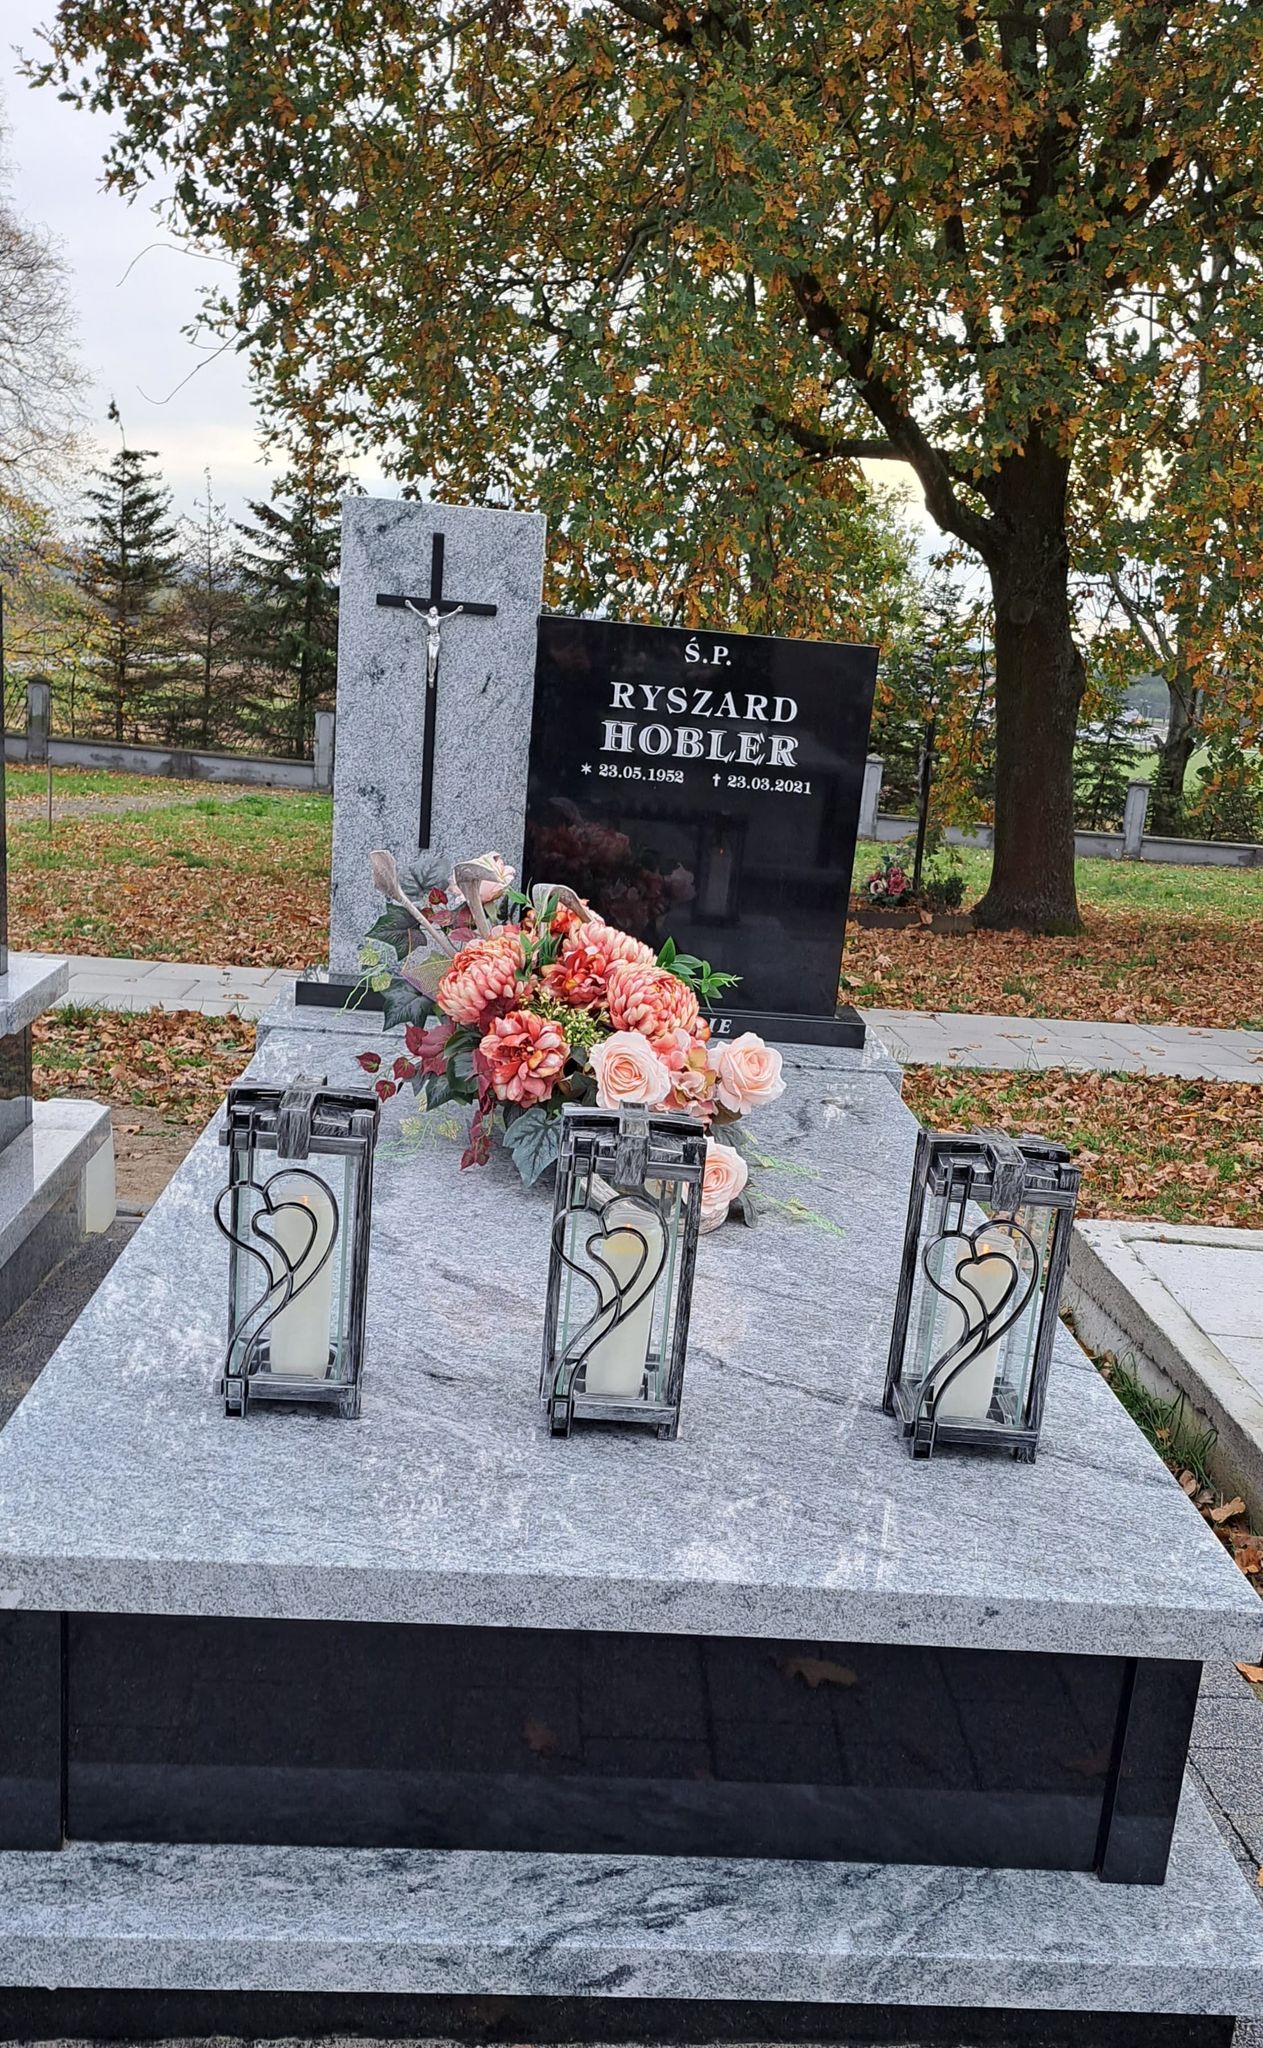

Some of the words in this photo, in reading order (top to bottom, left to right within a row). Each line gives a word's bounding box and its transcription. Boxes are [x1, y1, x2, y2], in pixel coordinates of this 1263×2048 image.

[684, 637, 732, 666] Ś.P.
[609, 681, 798, 723] RYSZARD
[599, 719, 799, 767] HOBLER
